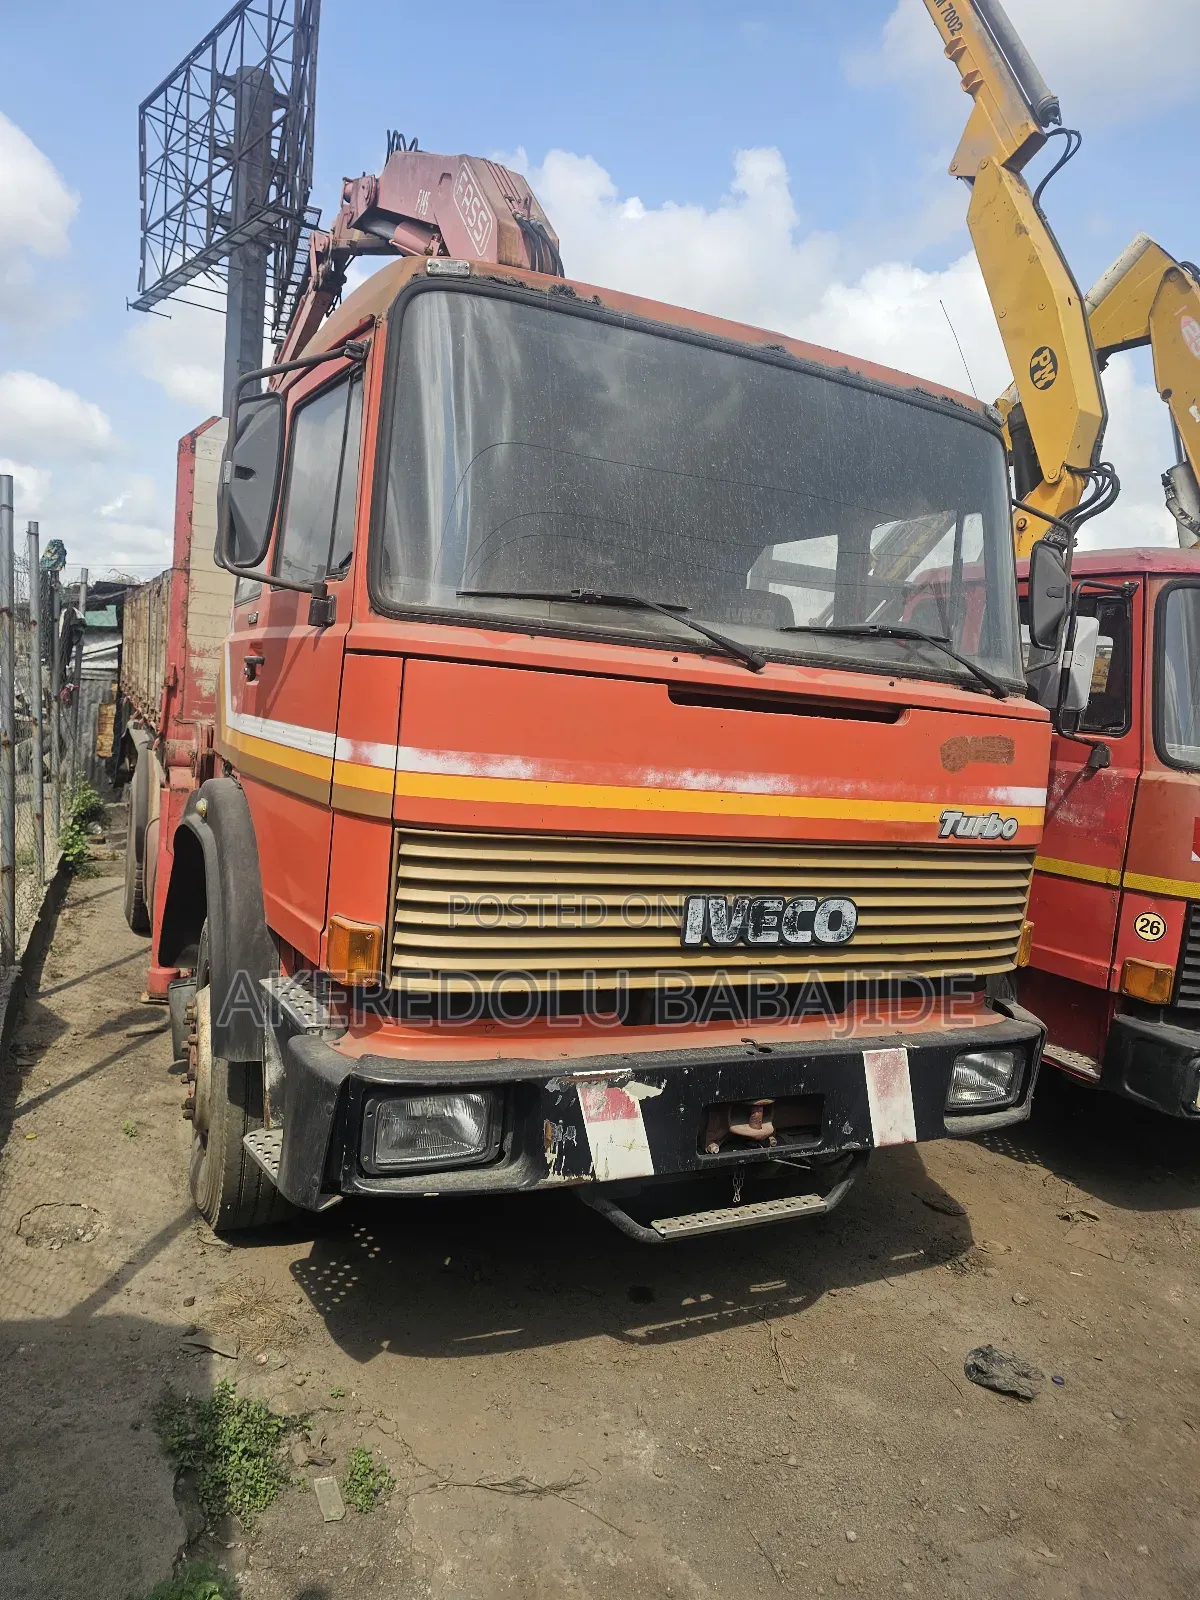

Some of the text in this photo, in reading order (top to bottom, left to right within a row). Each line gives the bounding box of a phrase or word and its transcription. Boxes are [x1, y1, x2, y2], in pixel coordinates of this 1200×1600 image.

[940, 2, 963, 36] 7002
[1031, 348, 1055, 389] PM
[938, 810, 1018, 840] Turbo
[682, 895, 859, 945] IVECO
[1139, 917, 1161, 936] 26
